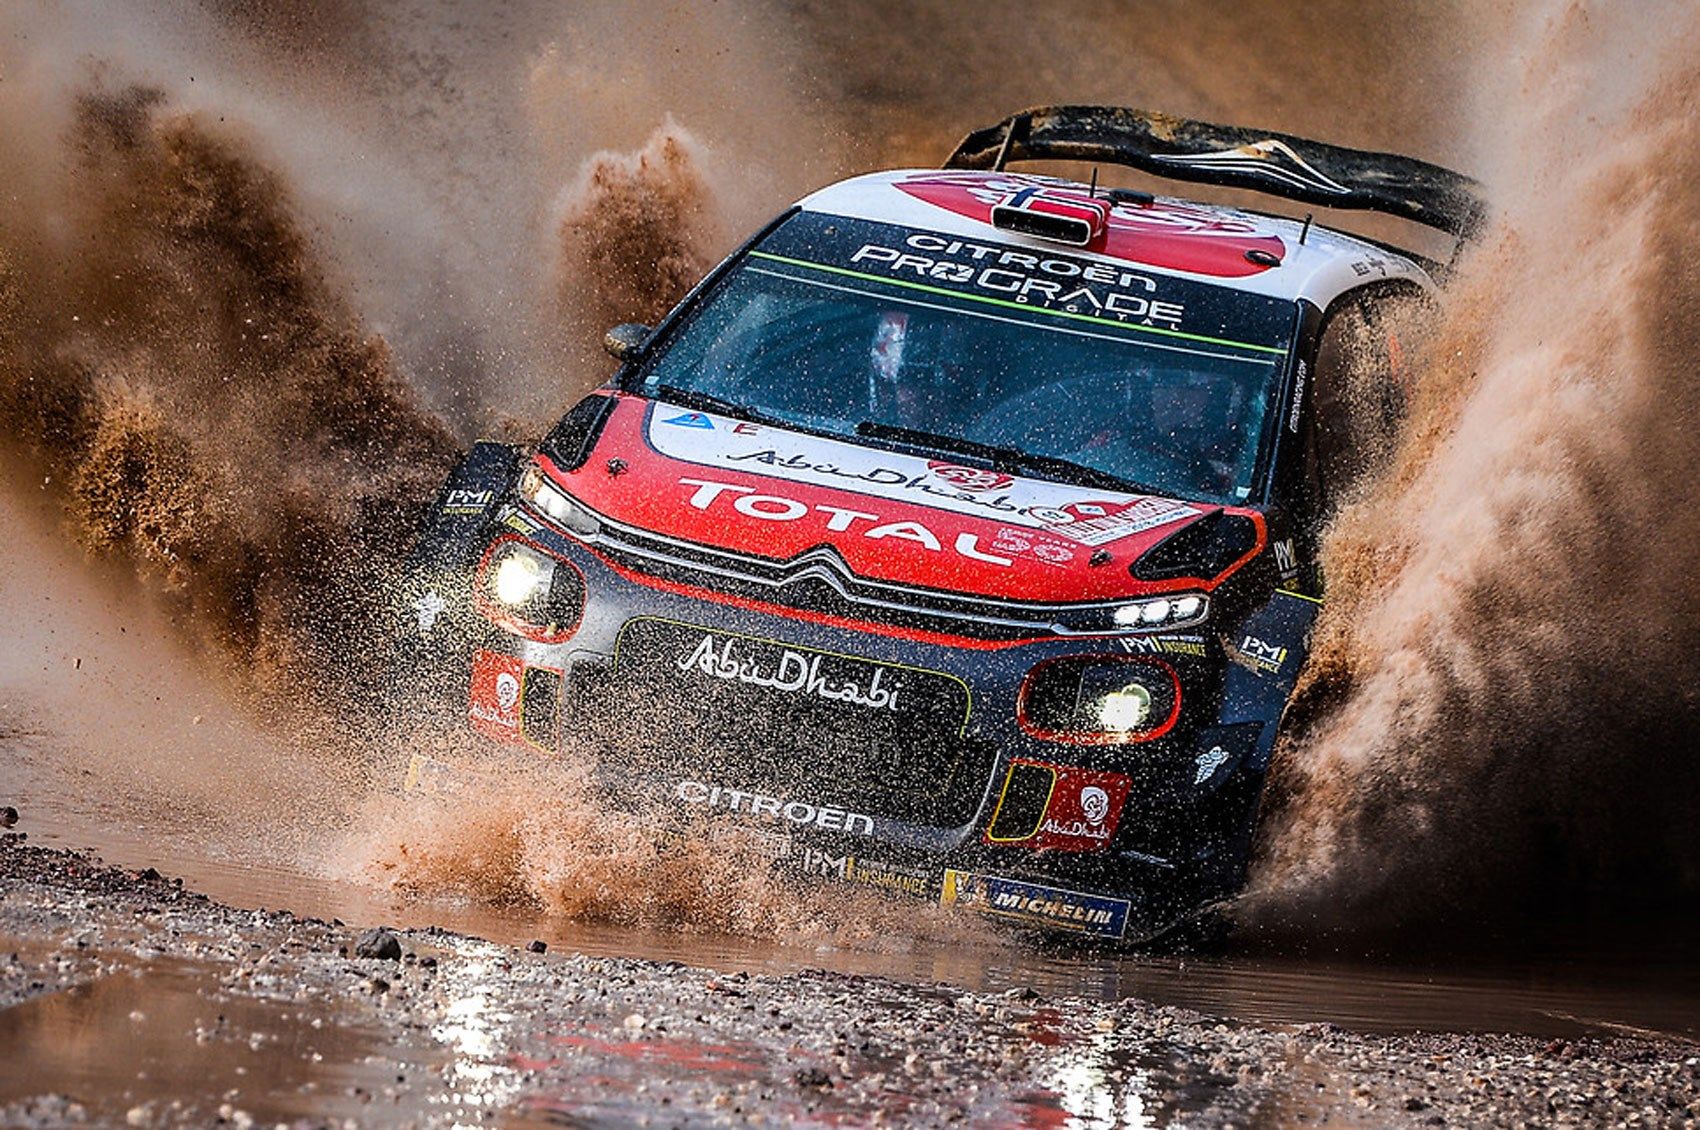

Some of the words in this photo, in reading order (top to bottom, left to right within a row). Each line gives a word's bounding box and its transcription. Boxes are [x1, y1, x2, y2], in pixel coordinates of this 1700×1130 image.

[906, 234, 1157, 292] CITROËN
[1016, 295, 1179, 331] DIGITAL
[678, 476, 1014, 567] TOTAL
[1241, 635, 1288, 663] PMI
[993, 891, 1114, 925] MICHELIN
